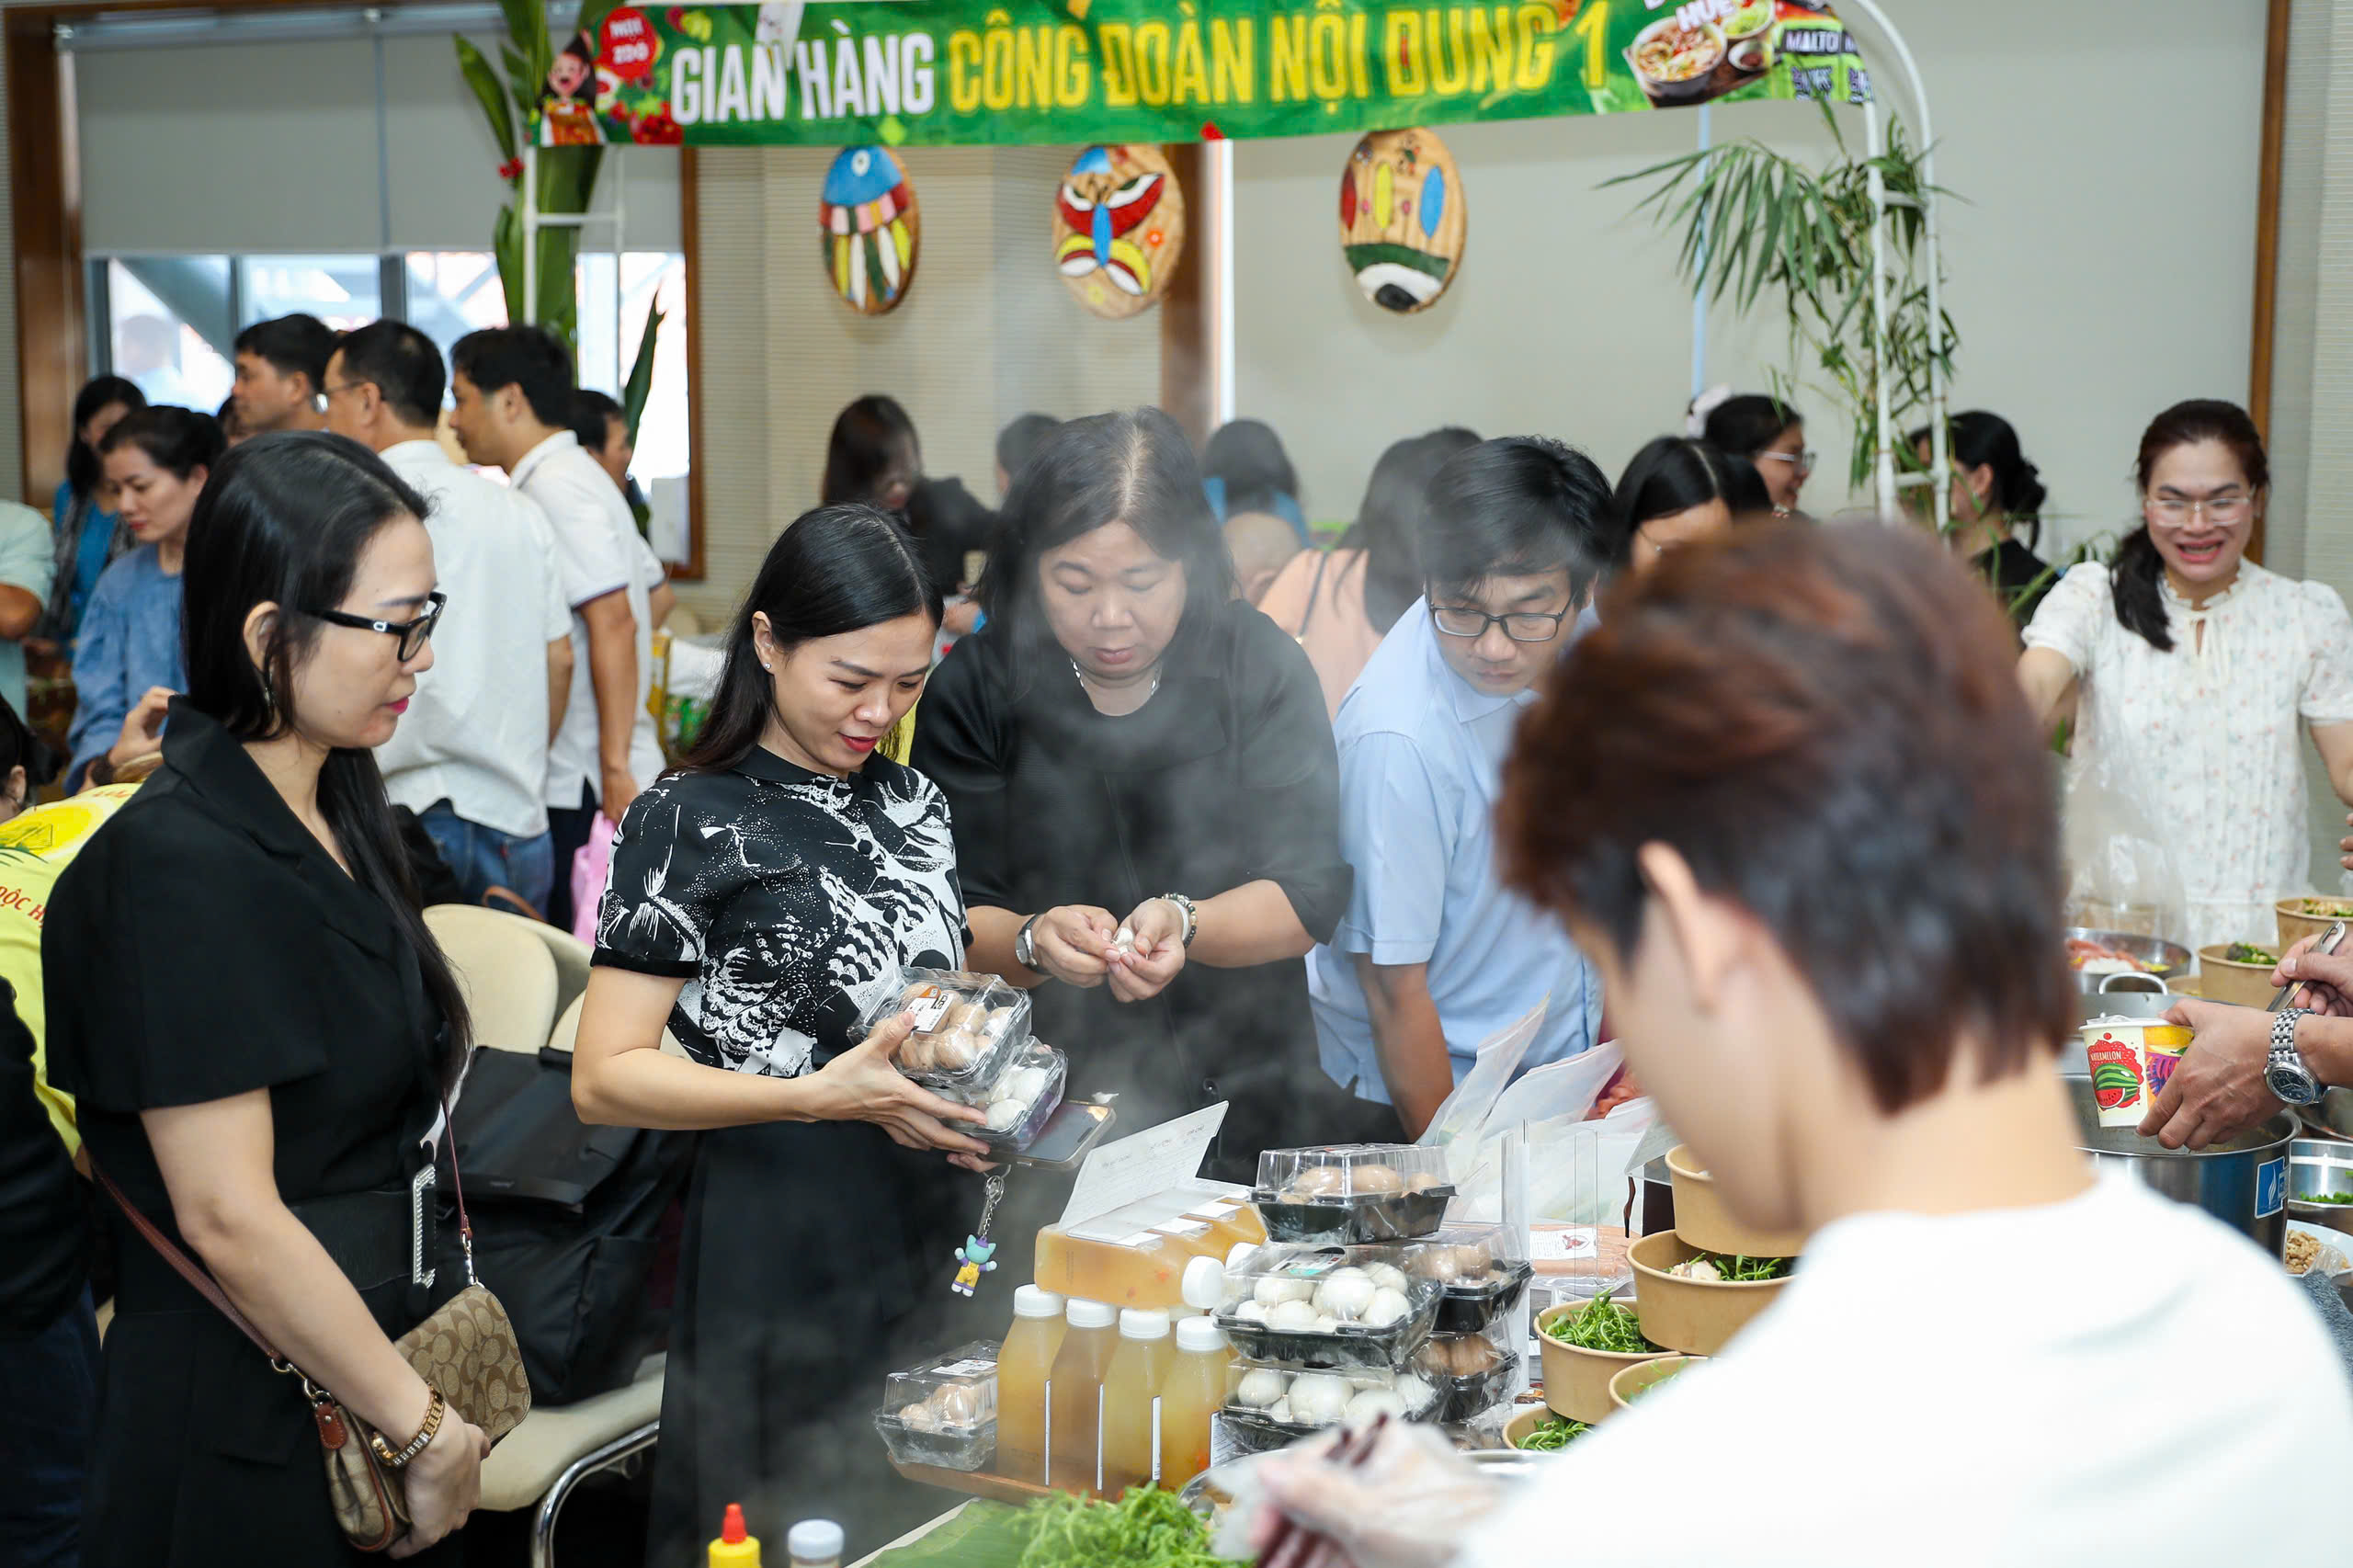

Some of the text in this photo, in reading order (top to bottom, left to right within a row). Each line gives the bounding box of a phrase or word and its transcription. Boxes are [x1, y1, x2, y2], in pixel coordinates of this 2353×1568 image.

[670, 0, 1608, 126] GIAN HÀNG CÔNG ĐOÀN NỘI DUNG 1
